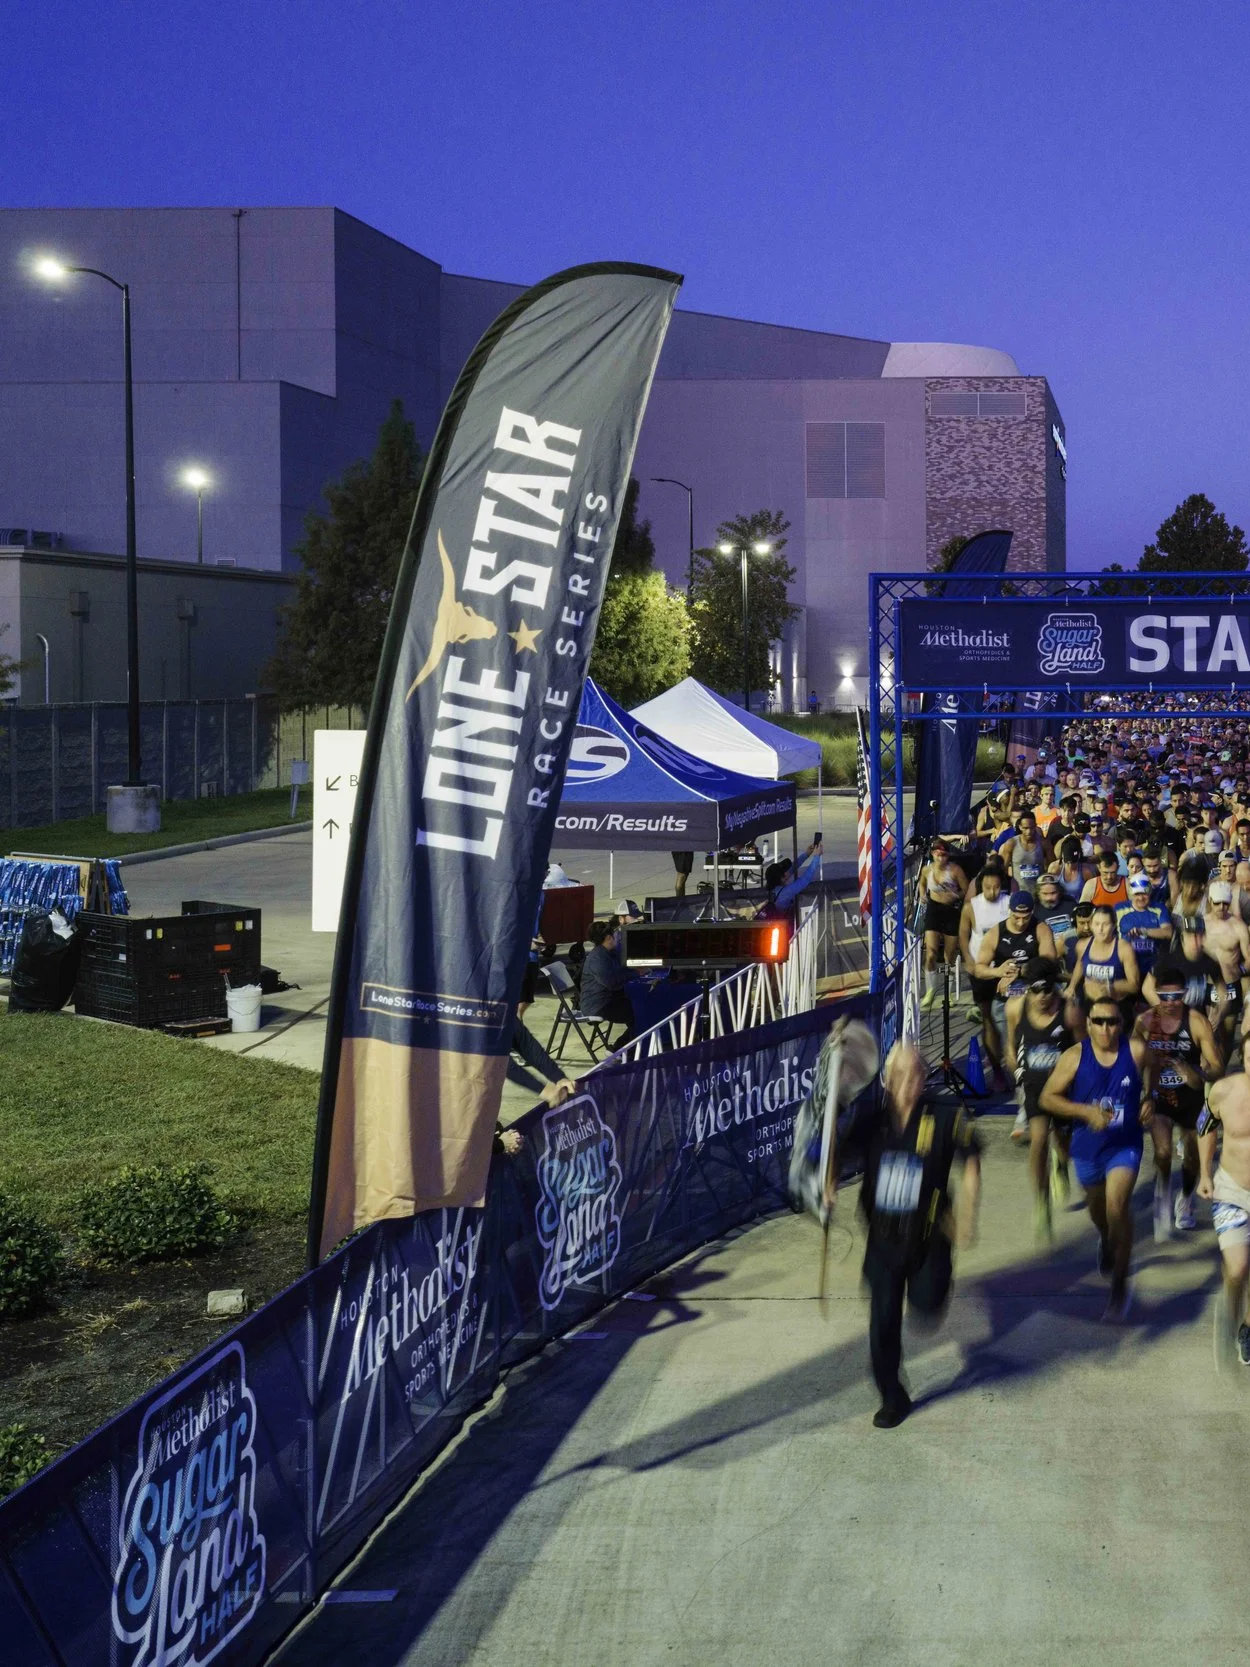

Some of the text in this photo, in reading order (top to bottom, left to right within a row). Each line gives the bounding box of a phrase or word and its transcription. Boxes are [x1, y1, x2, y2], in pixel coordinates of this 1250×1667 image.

[416, 406, 583, 860] LONE STAR
[528, 491, 608, 809] RACE SERIES
[919, 629, 1011, 647] Methodist
[1043, 628, 1098, 651] Sugar
[1045, 642, 1097, 670] Land
[1053, 619, 1092, 628] Methodist
[371, 990, 497, 1018] LoneStarRaceSeries.com
[684, 1064, 740, 1101] HOUSTON
[547, 1175, 616, 1293] Land
[341, 1225, 477, 1403] Methodist
[405, 1362, 435, 1402] SPORTS
[150, 1380, 236, 1474] Methodist
[125, 1411, 247, 1615] Sugar
[148, 1473, 249, 1667] Land
[200, 1562, 259, 1646] HALF
